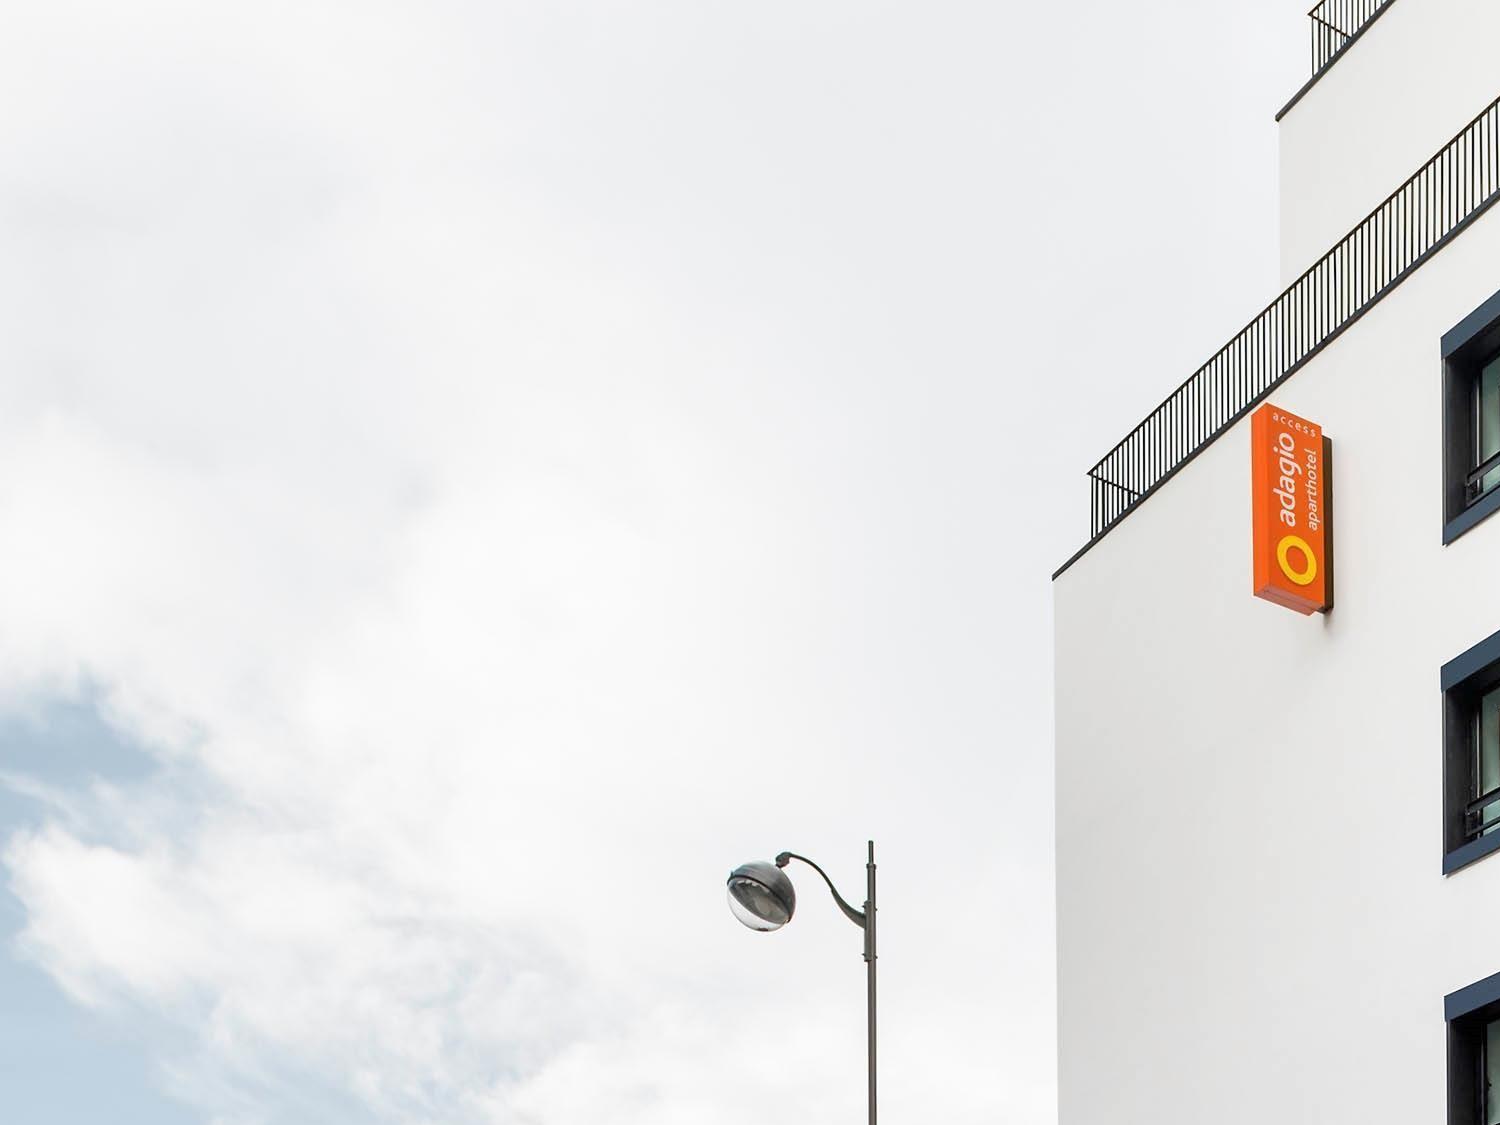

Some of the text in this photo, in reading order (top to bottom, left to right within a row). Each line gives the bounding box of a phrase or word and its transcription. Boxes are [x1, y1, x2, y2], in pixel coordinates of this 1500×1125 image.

[1273, 412, 1316, 437] access
[1273, 432, 1302, 527] adagio
[1303, 448, 1318, 531] aparthotel
